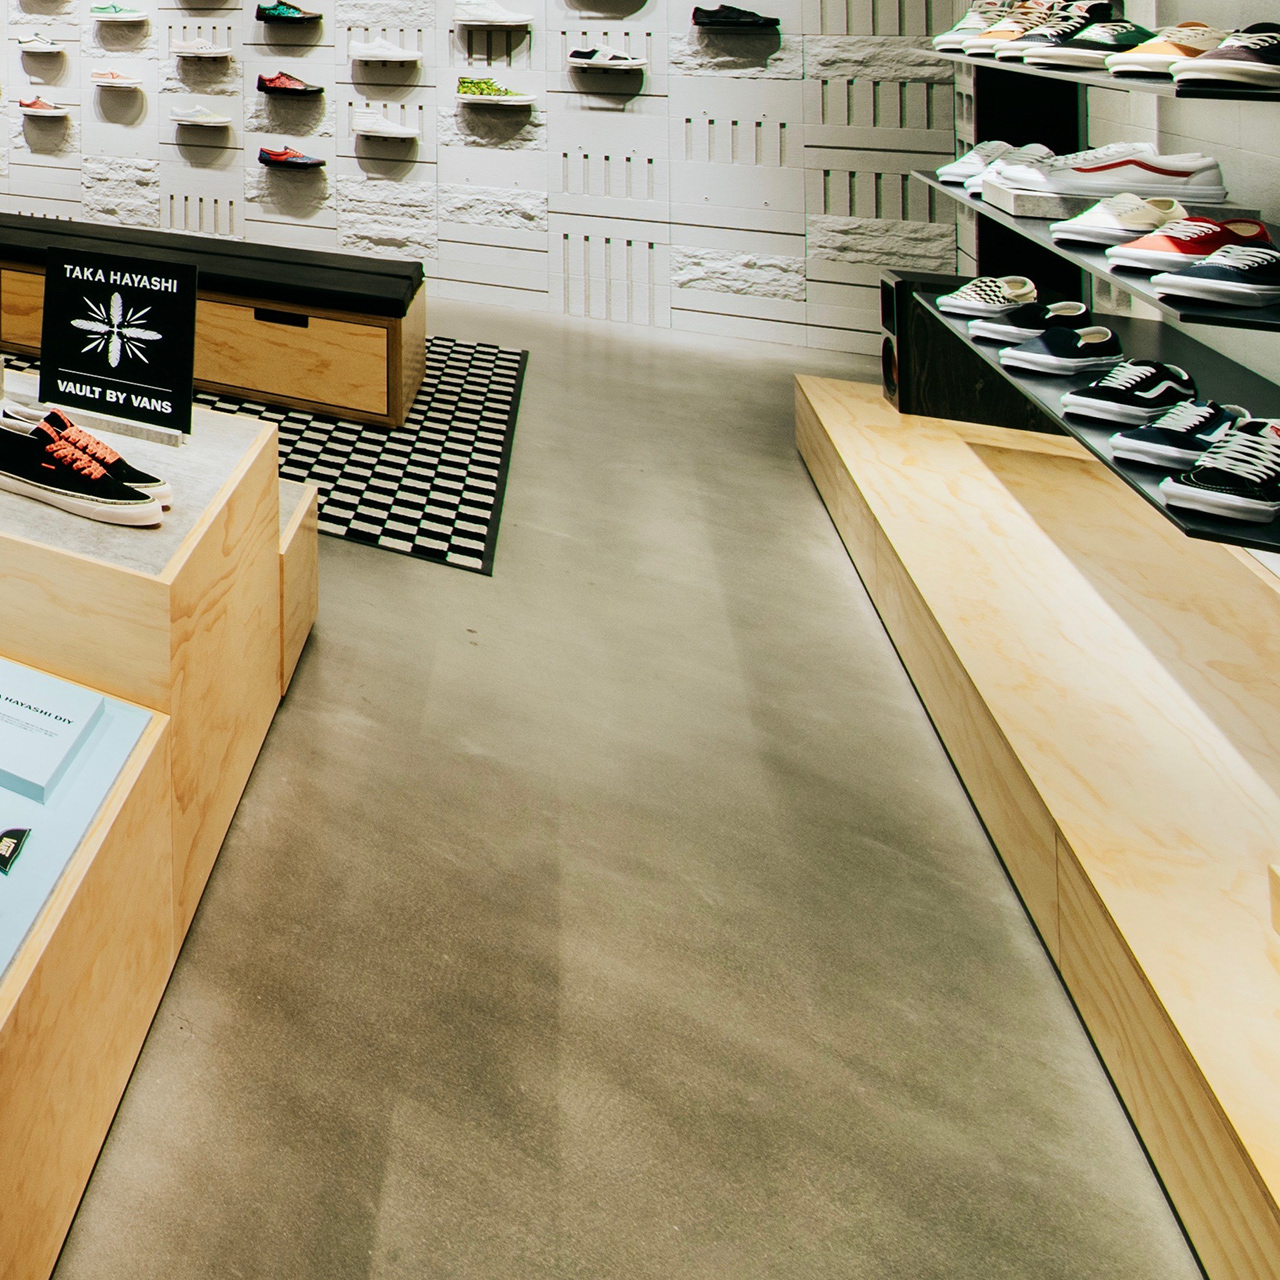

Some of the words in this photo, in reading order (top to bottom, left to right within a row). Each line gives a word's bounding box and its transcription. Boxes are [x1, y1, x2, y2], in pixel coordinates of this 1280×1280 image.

[63, 265, 105, 283] TAKA
[108, 270, 179, 294] HAYASHI
[56, 379, 102, 402] VAULT
[105, 387, 127, 405] BY
[130, 392, 173, 414] VANS
[4, 696, 53, 718] HAYASHI
[53, 714, 75, 725] DIY
